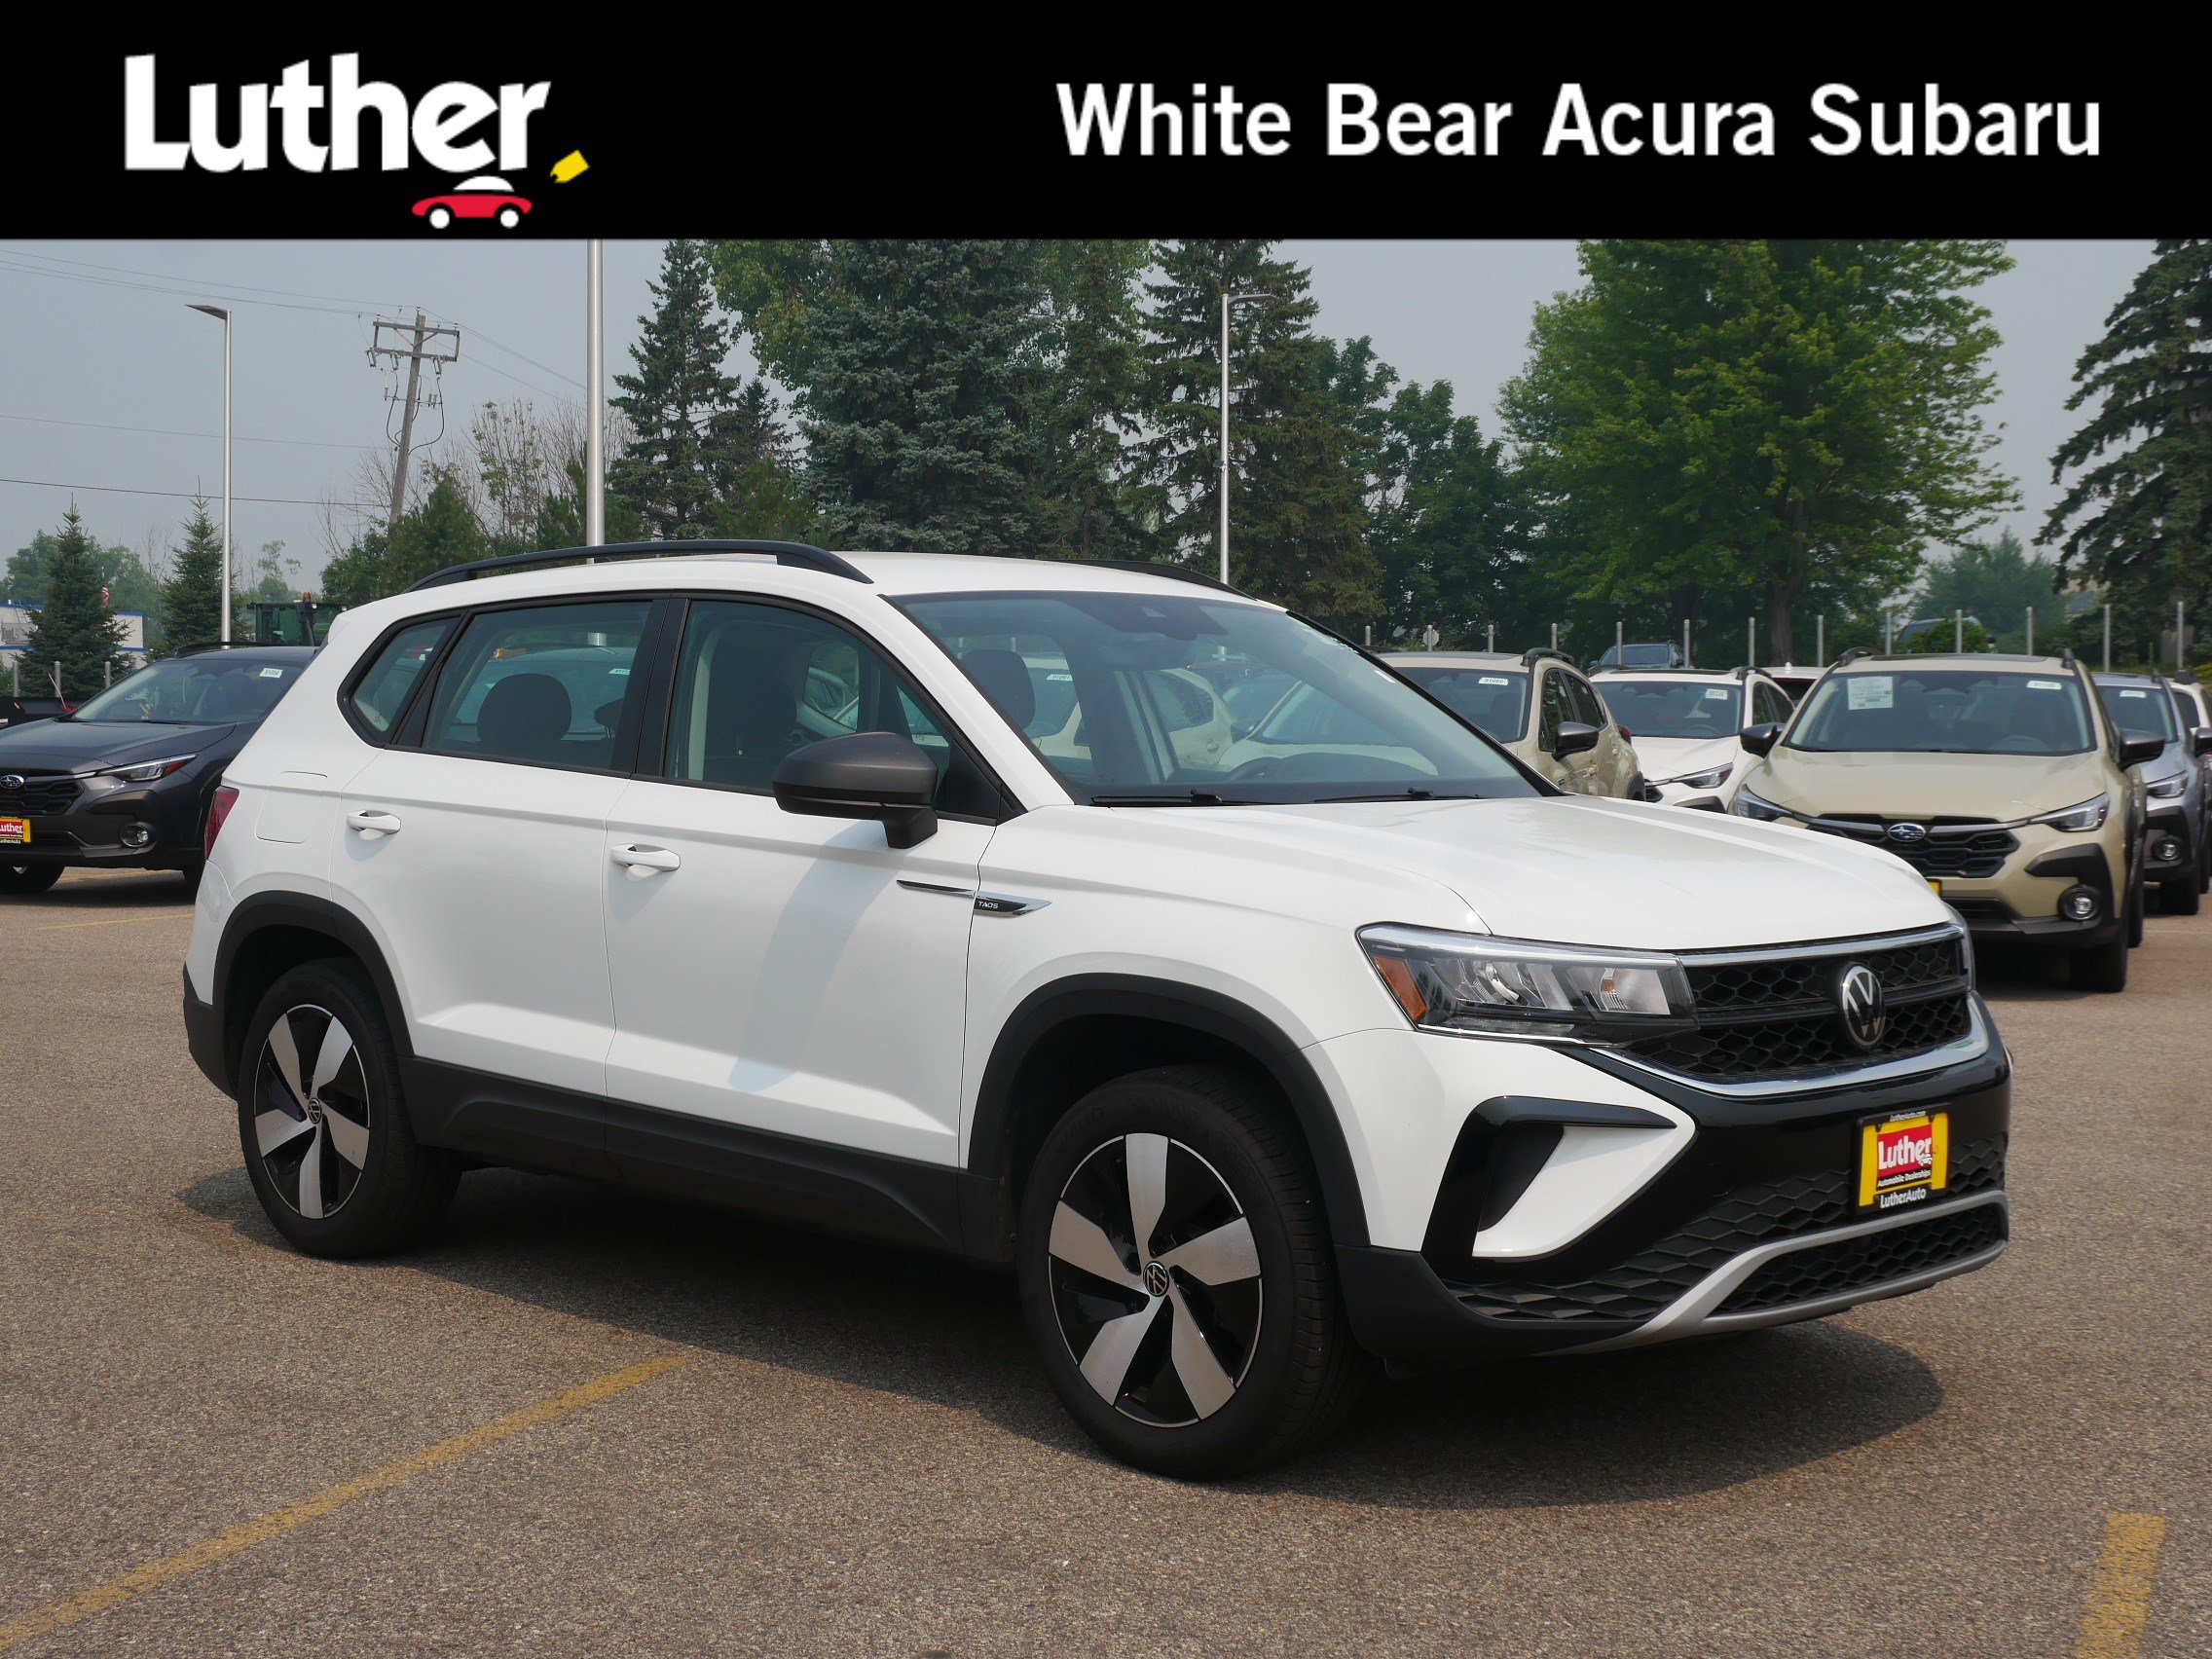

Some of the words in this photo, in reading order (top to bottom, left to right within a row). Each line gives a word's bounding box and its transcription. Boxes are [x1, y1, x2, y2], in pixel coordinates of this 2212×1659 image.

[977, 900, 999, 909] TAOS
[1878, 1134, 1932, 1170] Luther
[1880, 1187, 1927, 1209] LutherAuto
